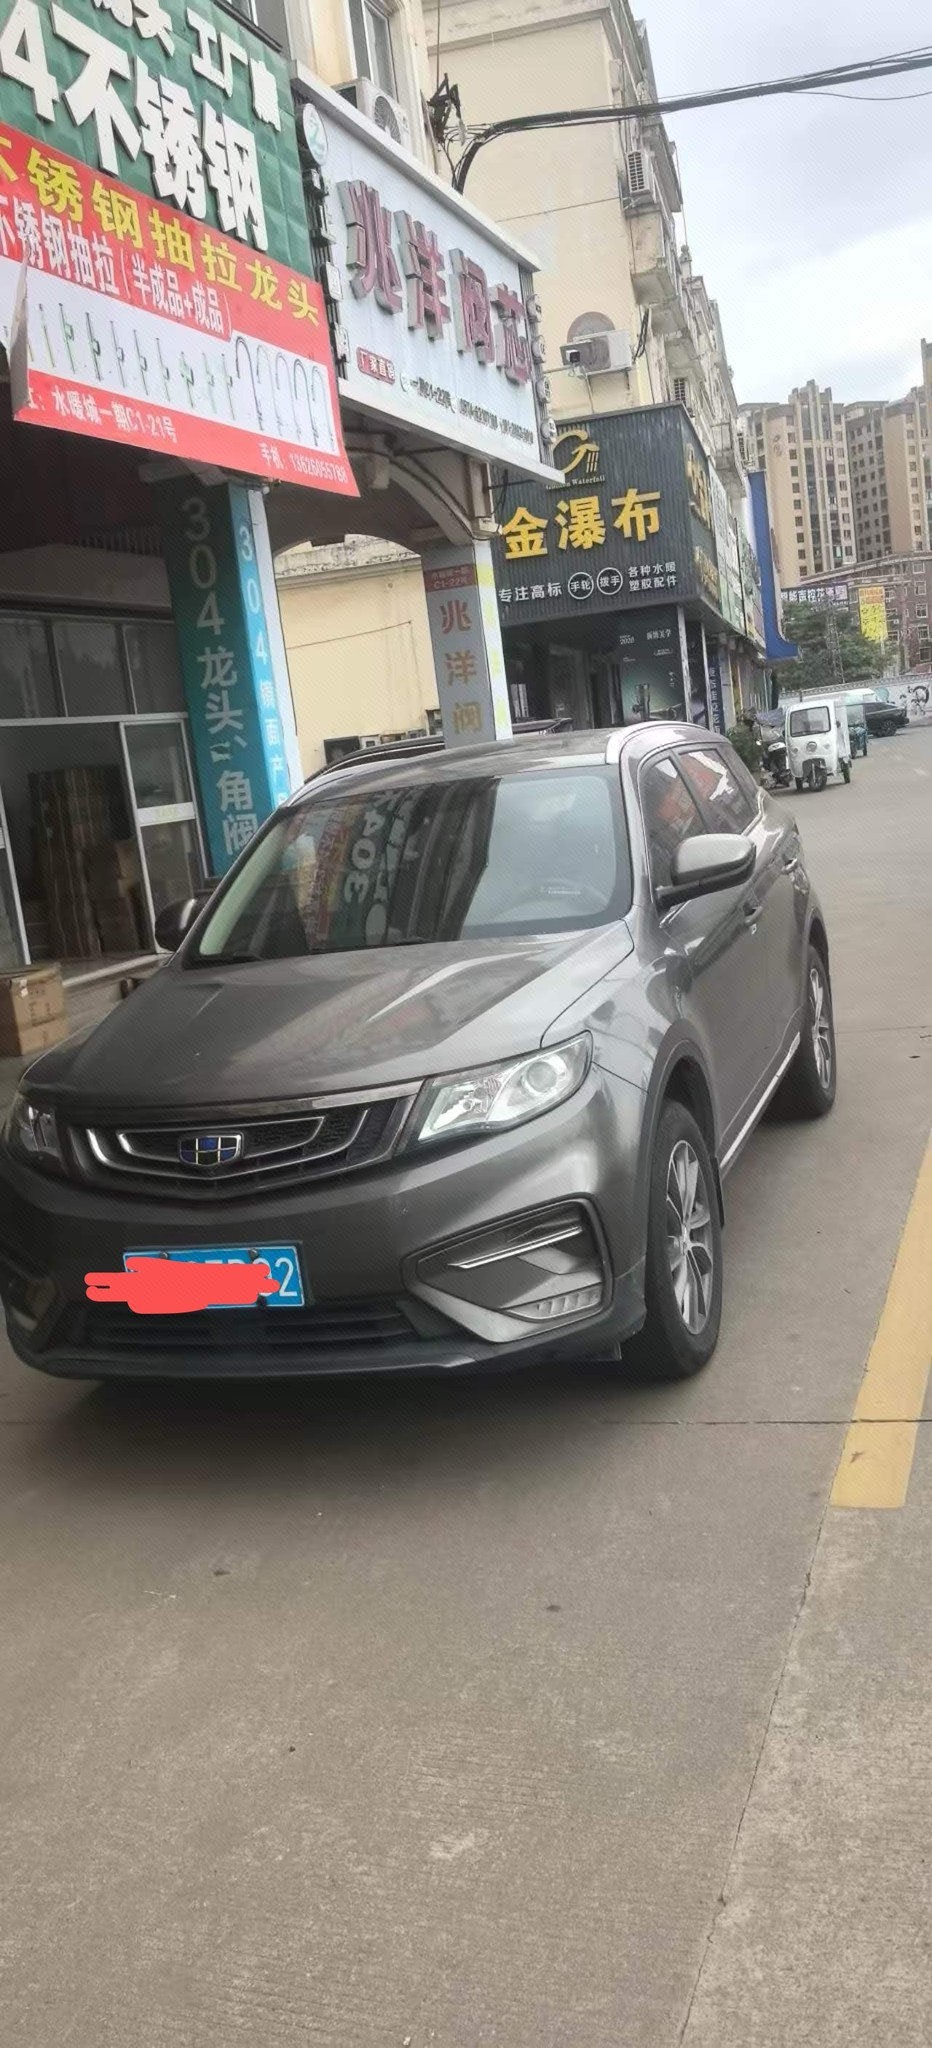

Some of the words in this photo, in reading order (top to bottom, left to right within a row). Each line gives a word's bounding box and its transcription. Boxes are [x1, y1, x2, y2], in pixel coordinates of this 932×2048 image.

[499, 487, 662, 561] 金瀑布
[627, 560, 677, 578] 各种水暖
[570, 581, 592, 592] 手轮
[628, 575, 679, 592] 塑胶配件
[498, 582, 563, 604] 专注高标
